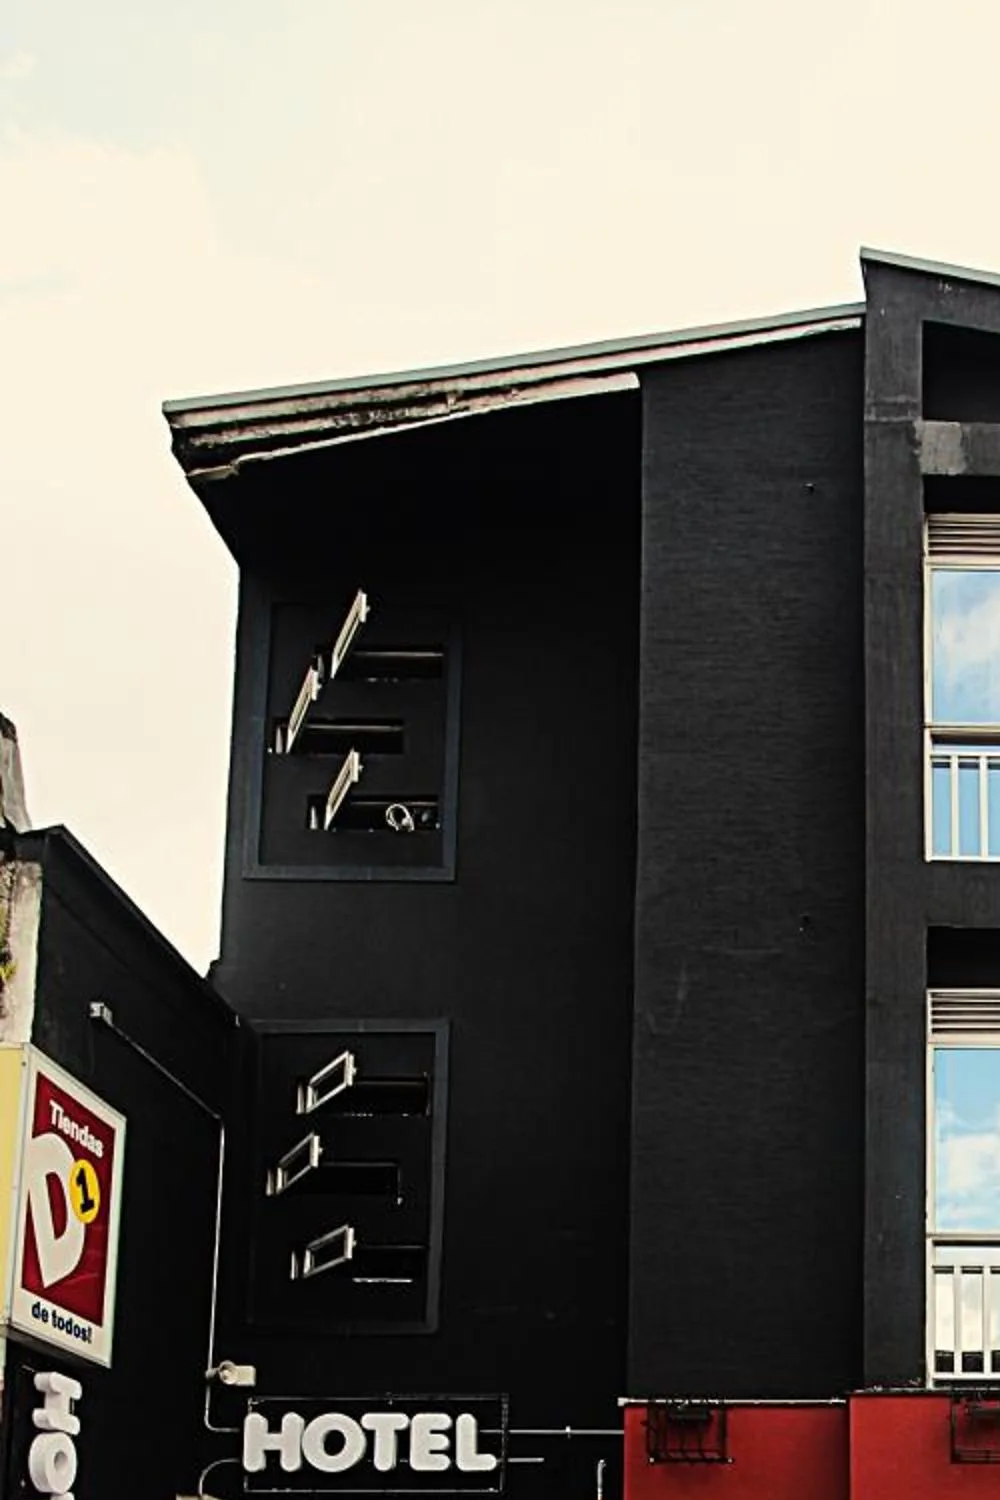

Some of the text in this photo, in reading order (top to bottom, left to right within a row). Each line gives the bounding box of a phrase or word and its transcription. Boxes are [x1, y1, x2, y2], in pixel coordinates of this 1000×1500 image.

[50, 1100, 104, 1158] Tiendas
[32, 1301, 92, 1344] de todos!
[243, 1412, 498, 1473] HOTEL
